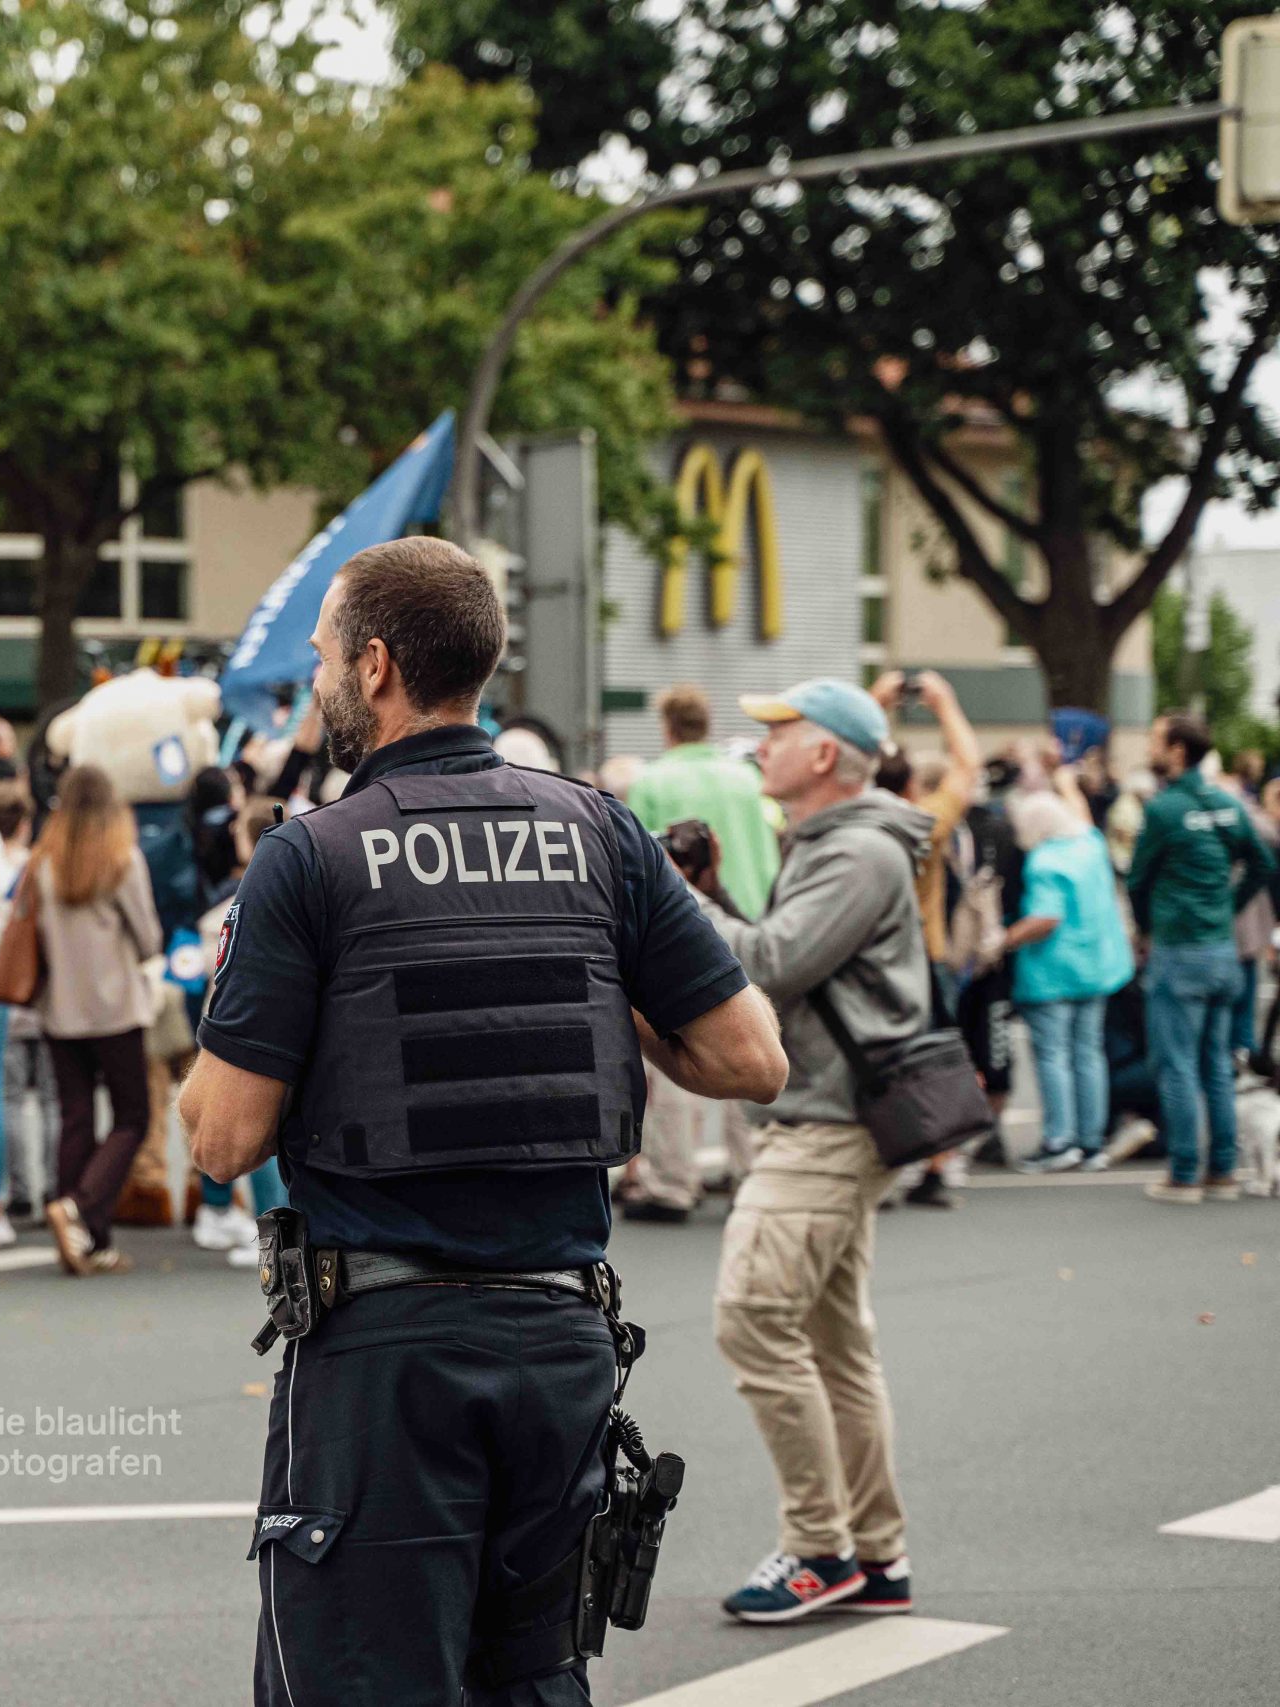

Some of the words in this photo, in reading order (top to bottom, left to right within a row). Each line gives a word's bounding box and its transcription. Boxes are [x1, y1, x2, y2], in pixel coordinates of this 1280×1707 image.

[360, 820, 588, 889] POLIZEI
[260, 1514, 302, 1533] POLIZEI
[786, 1568, 828, 1603] N
